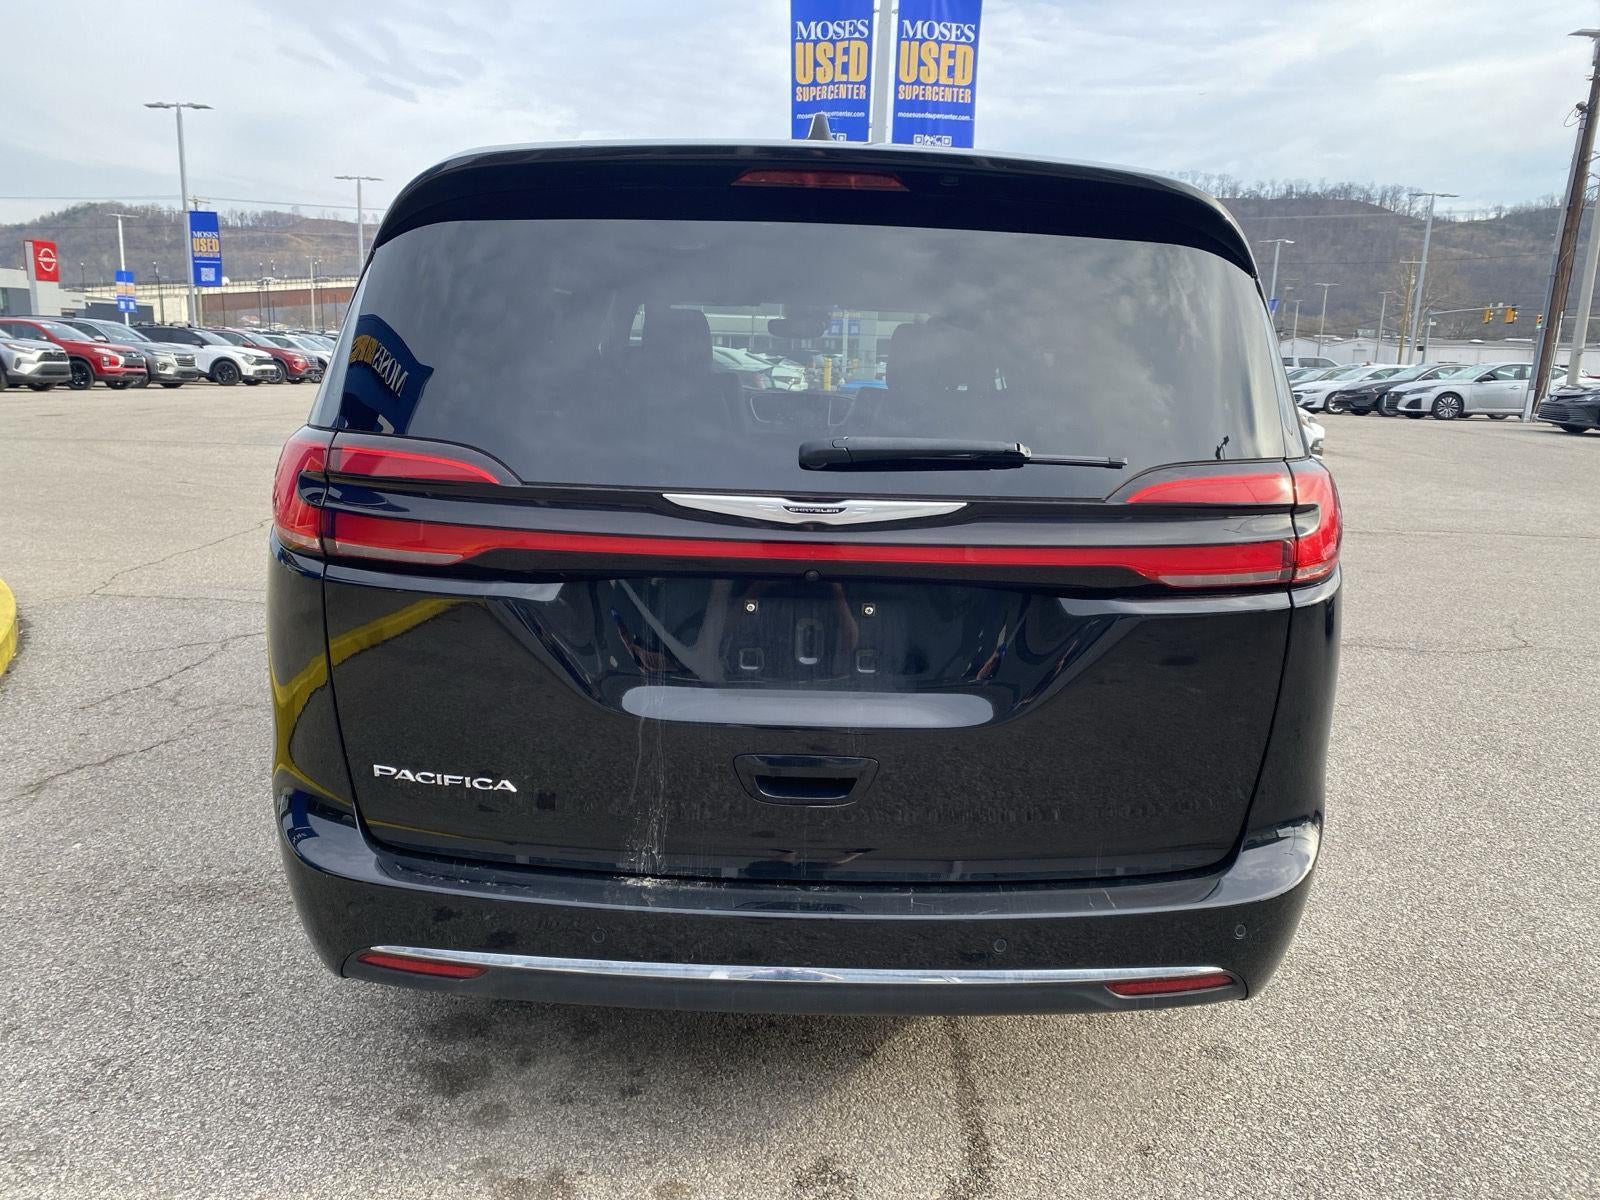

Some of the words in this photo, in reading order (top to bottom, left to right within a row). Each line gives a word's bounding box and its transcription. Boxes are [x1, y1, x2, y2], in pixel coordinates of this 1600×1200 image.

[796, 19, 869, 41] MOSES
[902, 19, 975, 43] MOSES
[795, 40, 868, 85] USED
[899, 40, 974, 86] USED
[796, 84, 866, 102] SUPERCENTER
[898, 84, 971, 103] SUPERCENTER
[192, 238, 220, 252] USED
[373, 764, 518, 792] PACIFICA
